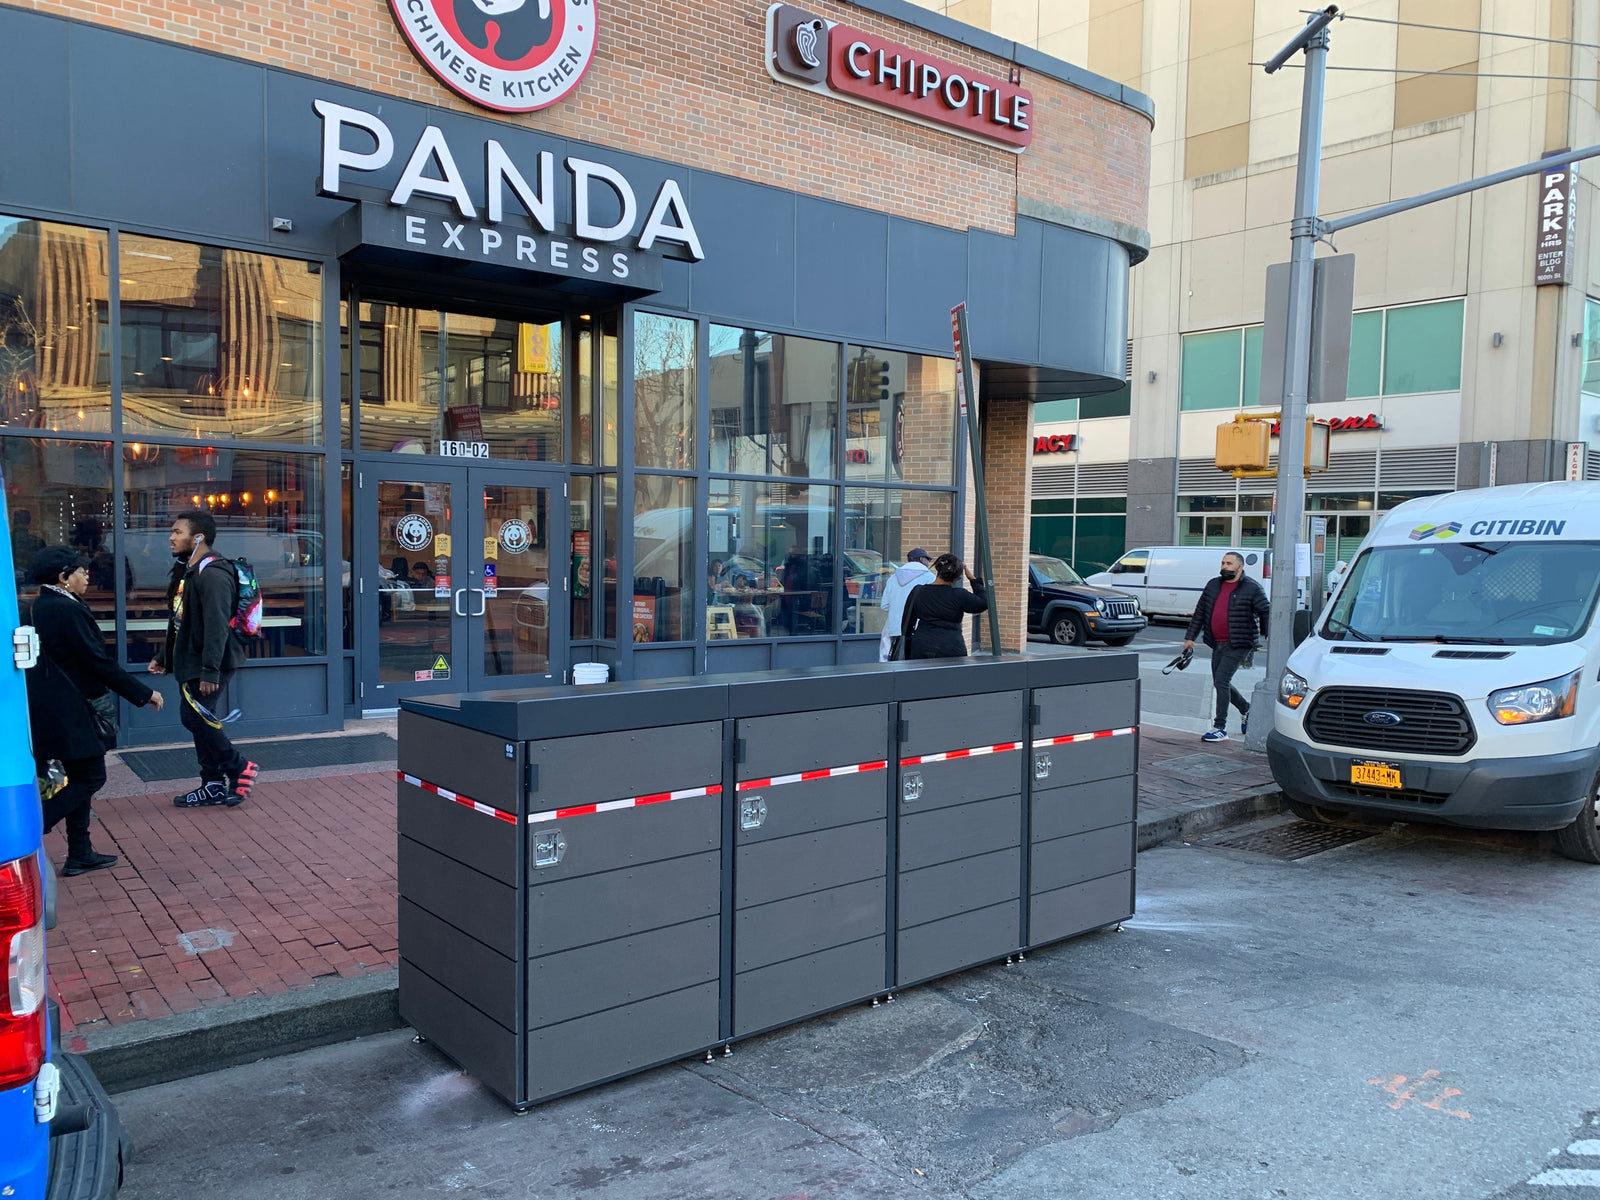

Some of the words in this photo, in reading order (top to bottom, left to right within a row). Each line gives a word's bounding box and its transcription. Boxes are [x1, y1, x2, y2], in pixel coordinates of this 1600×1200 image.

[407, 0, 493, 92] CHINESE
[502, 45, 582, 98] KITCHEN
[847, 41, 1030, 130] CHIPOTLE
[312, 98, 705, 261] PANDA
[1542, 173, 1565, 232] PARK
[1540, 240, 1562, 248] HRS
[1545, 233, 1559, 241] 24
[405, 215, 630, 279] EXPRESS
[1538, 250, 1563, 260] ENTER
[1540, 258, 1561, 267] BLDG
[1544, 265, 1555, 273] AT
[441, 441, 488, 458] 160-02
[1469, 519, 1567, 536] CITIBIN
